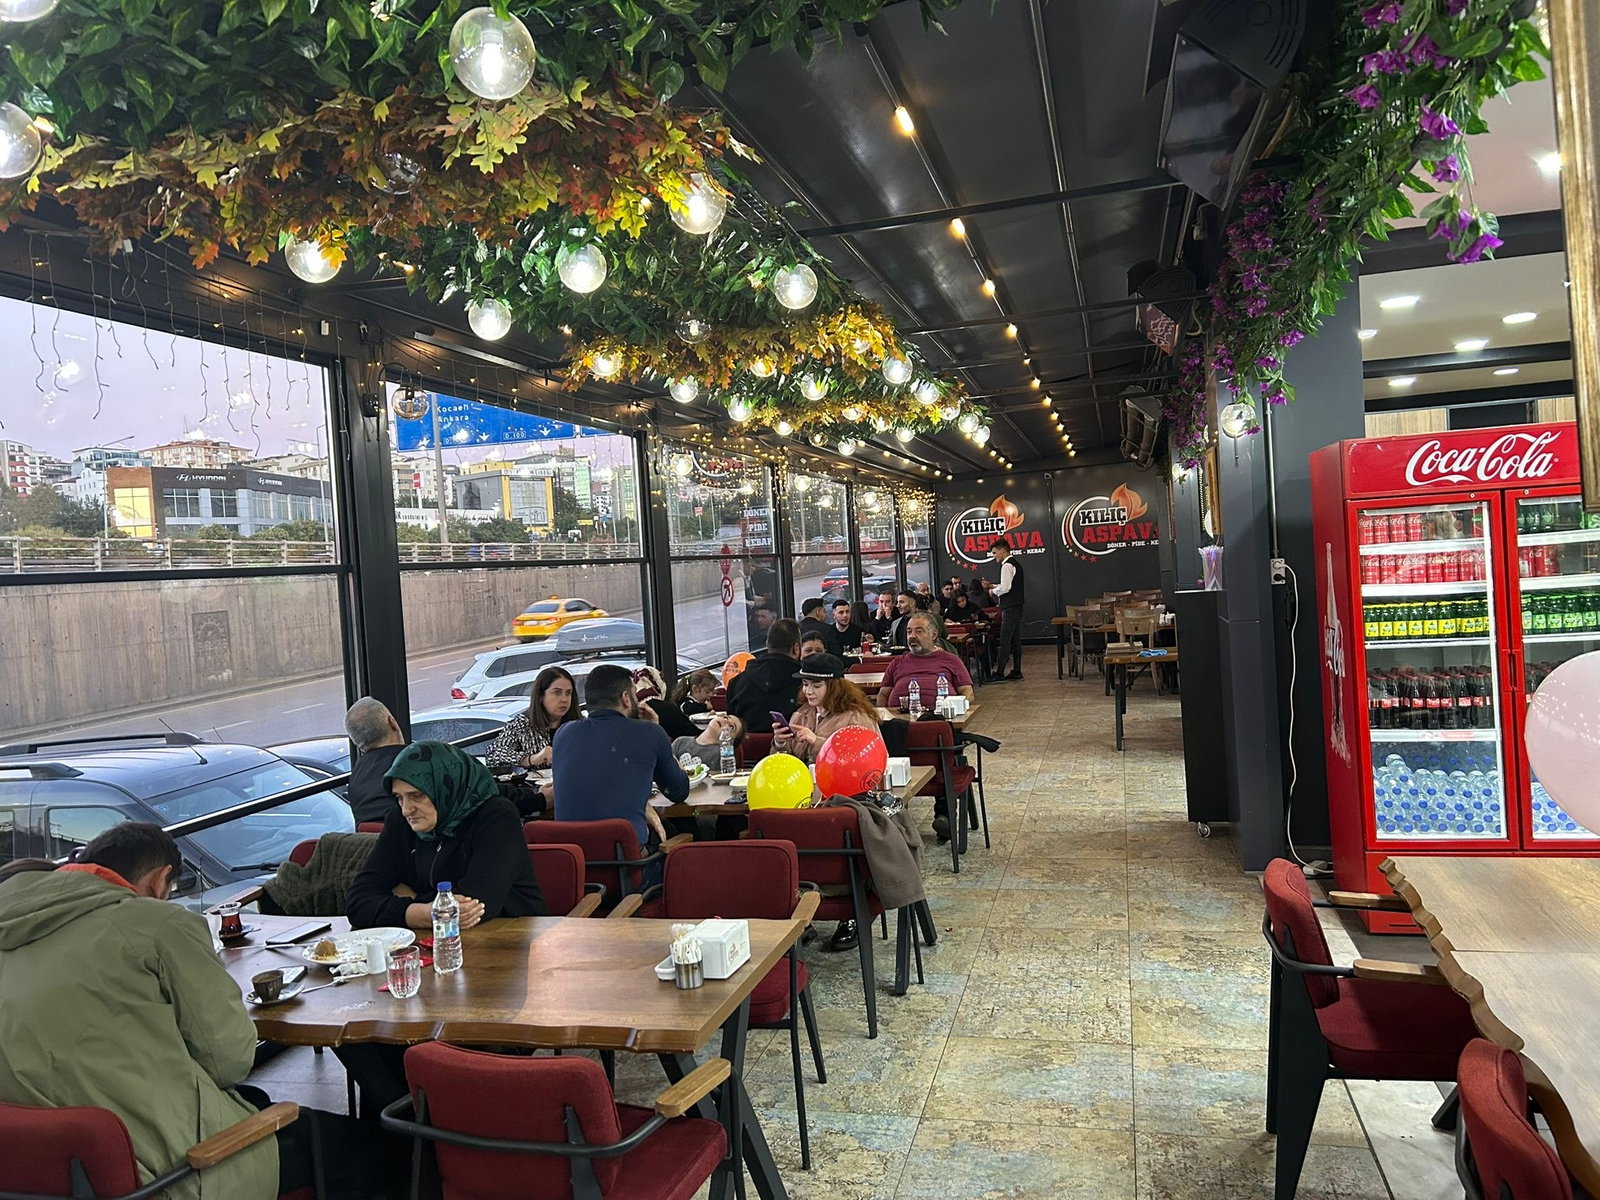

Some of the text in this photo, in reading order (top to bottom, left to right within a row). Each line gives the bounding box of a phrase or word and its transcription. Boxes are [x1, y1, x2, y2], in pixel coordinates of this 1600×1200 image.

[438, 414, 469, 423] Ankara
[1405, 431, 1562, 486] Coca-Cola
[1080, 507, 1127, 526] KILIÇ
[962, 517, 1006, 535] KILIÇ
